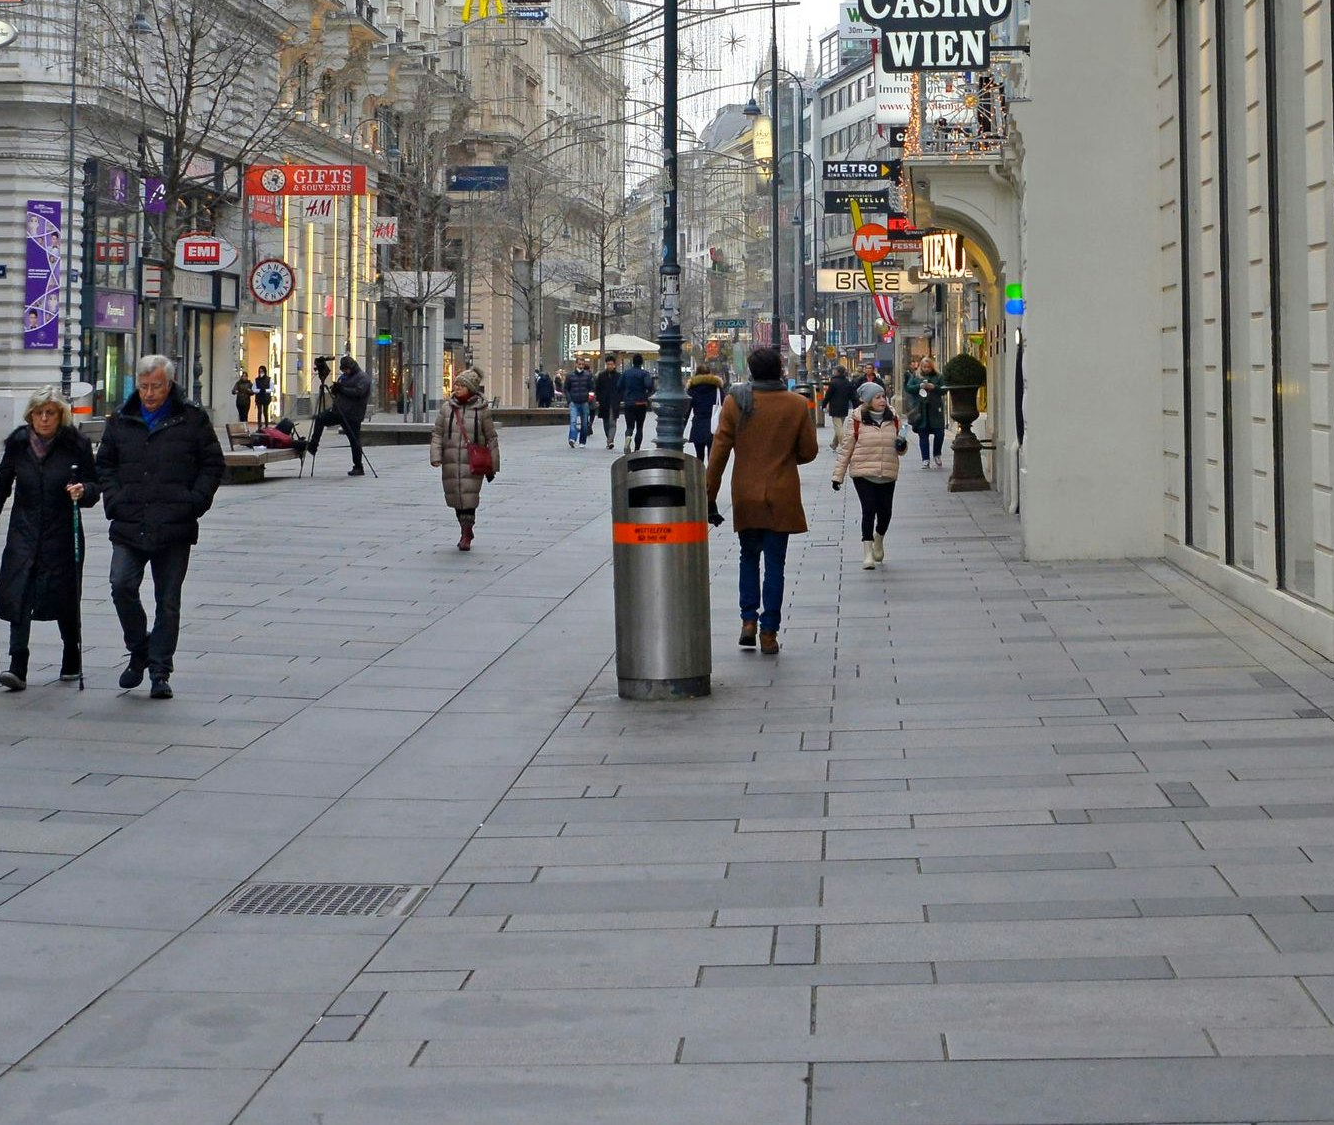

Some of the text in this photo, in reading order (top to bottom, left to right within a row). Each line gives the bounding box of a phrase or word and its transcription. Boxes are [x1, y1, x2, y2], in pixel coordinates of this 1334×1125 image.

[848, 26, 863, 34] 30m
[885, 29, 986, 67] WIEN
[827, 163, 878, 173] METRO
[293, 169, 352, 184] GIFTS
[188, 246, 216, 257] EMI
[256, 264, 290, 278] PLANET
[253, 285, 290, 300] VIENNA
